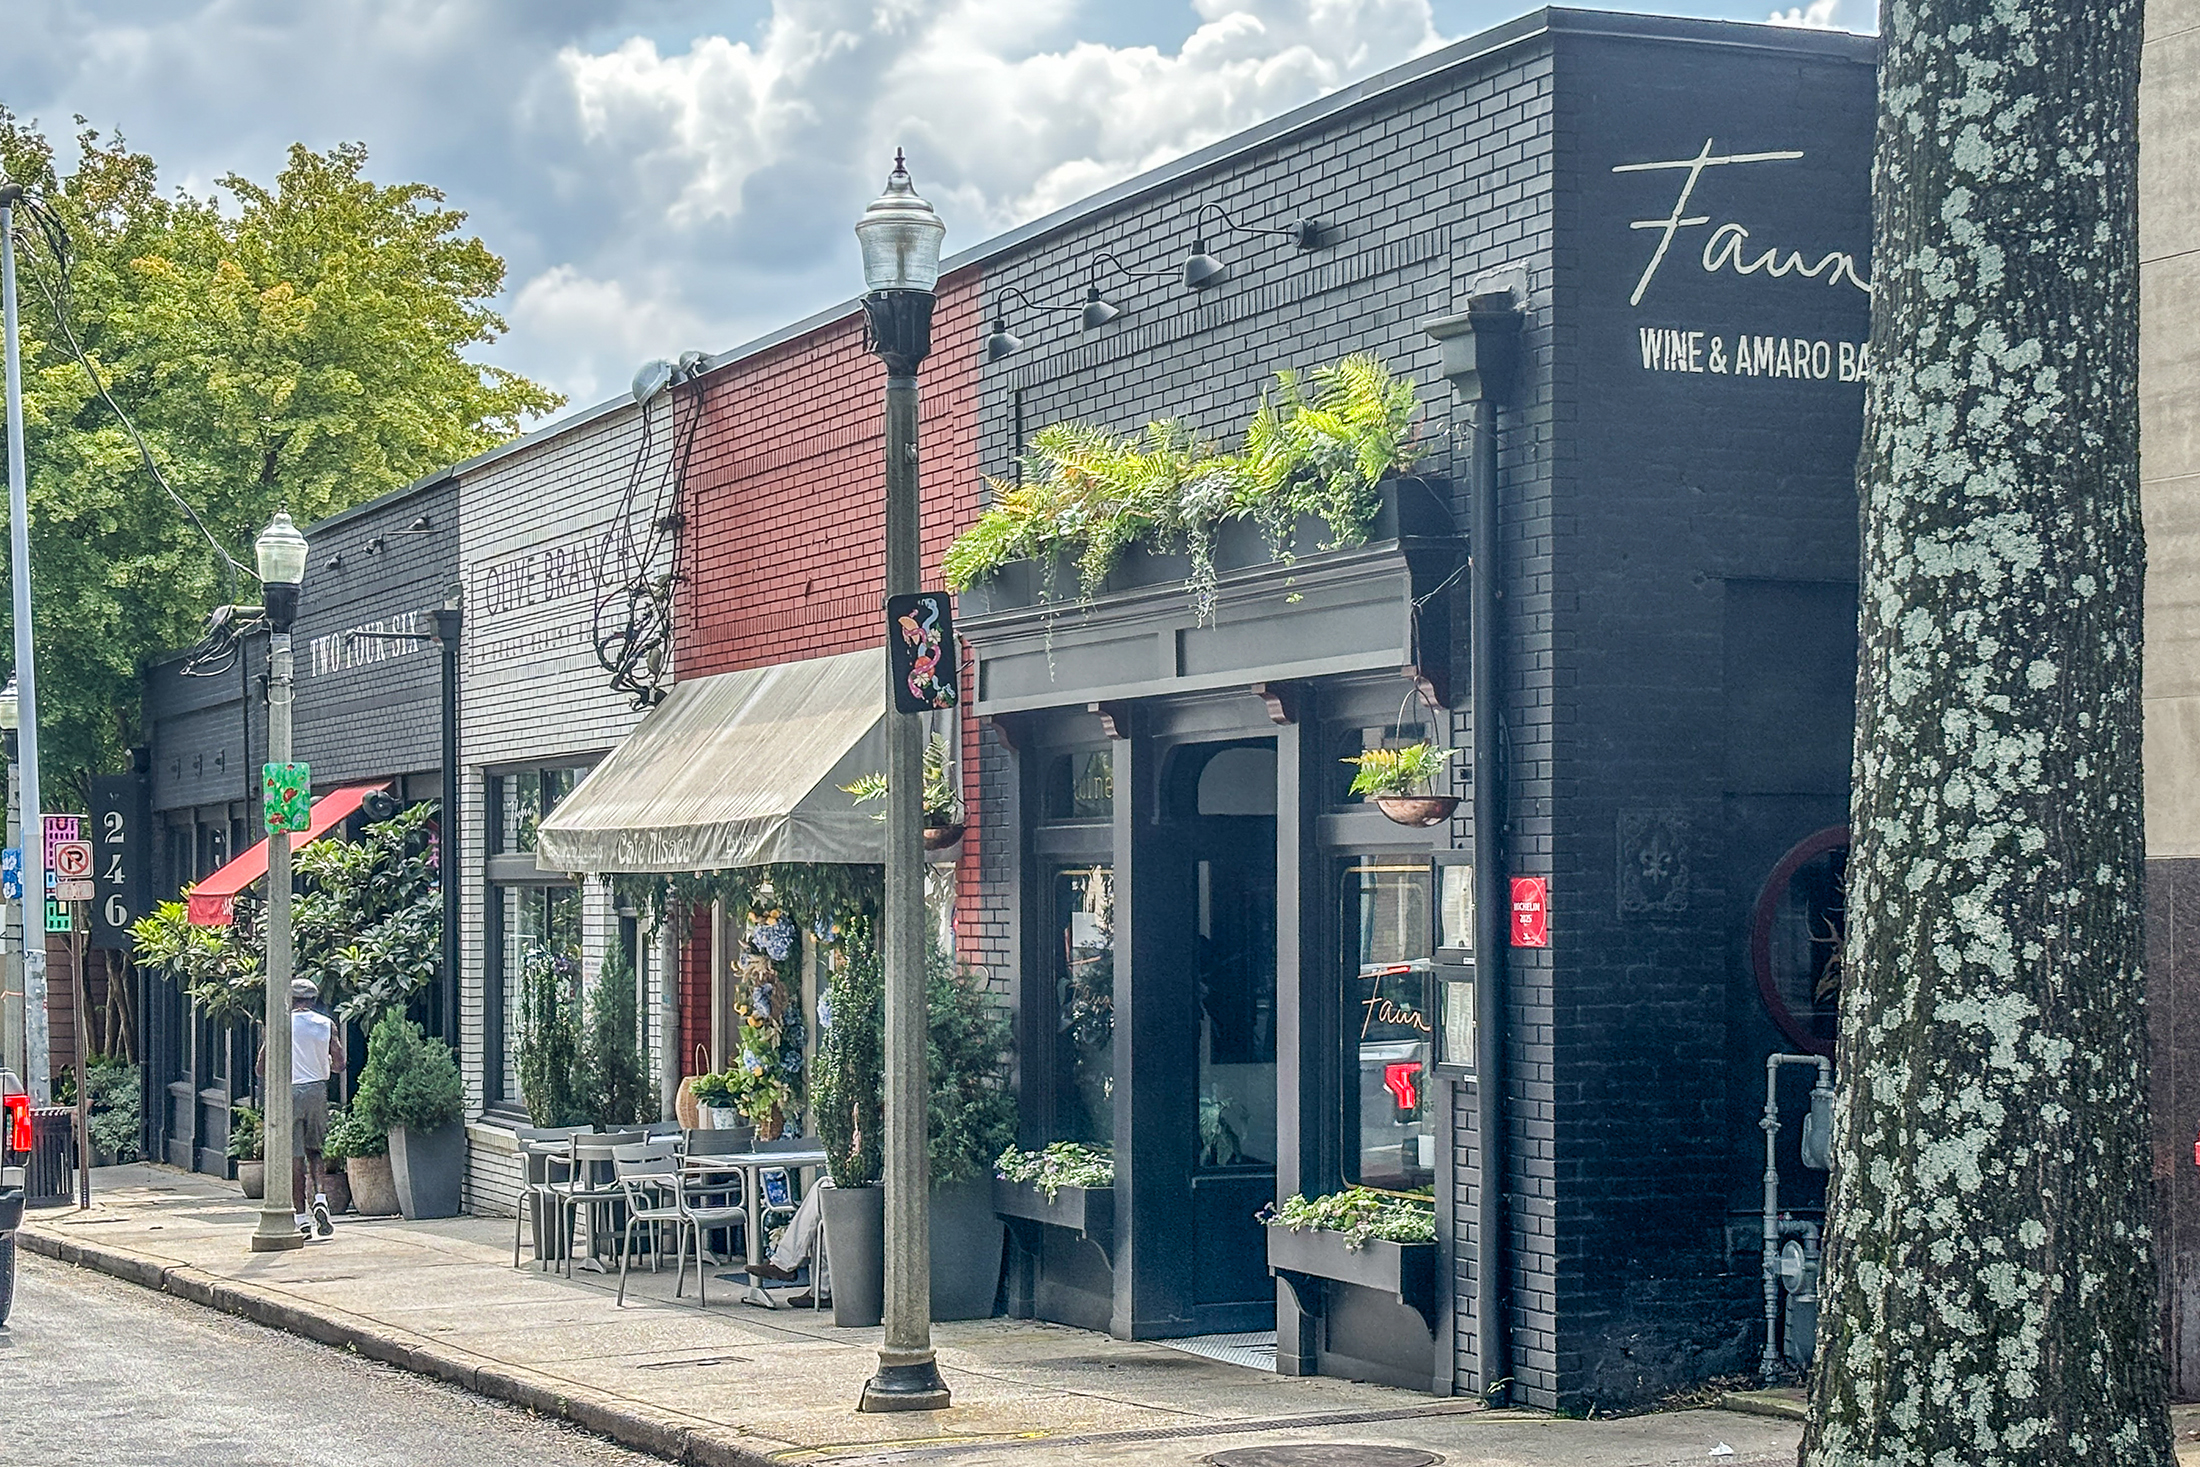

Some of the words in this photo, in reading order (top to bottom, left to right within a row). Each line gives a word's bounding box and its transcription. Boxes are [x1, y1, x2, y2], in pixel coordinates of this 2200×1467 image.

[1611, 137, 1871, 306] Faun
[1640, 327, 1704, 373] WINE
[1709, 336, 1727, 374] &
[1735, 335, 1830, 380] AMARO
[1838, 341, 1870, 382] BA
[486, 556, 536, 617] OLIVE
[545, 532, 629, 602] BRANCH
[310, 632, 340, 677] TWO
[392, 611, 419, 658] SIX
[103, 811, 128, 927] 246
[648, 830, 691, 864] Alsace
[1514, 902, 1540, 911] MICHELIN
[1358, 969, 1431, 1039] Faun
